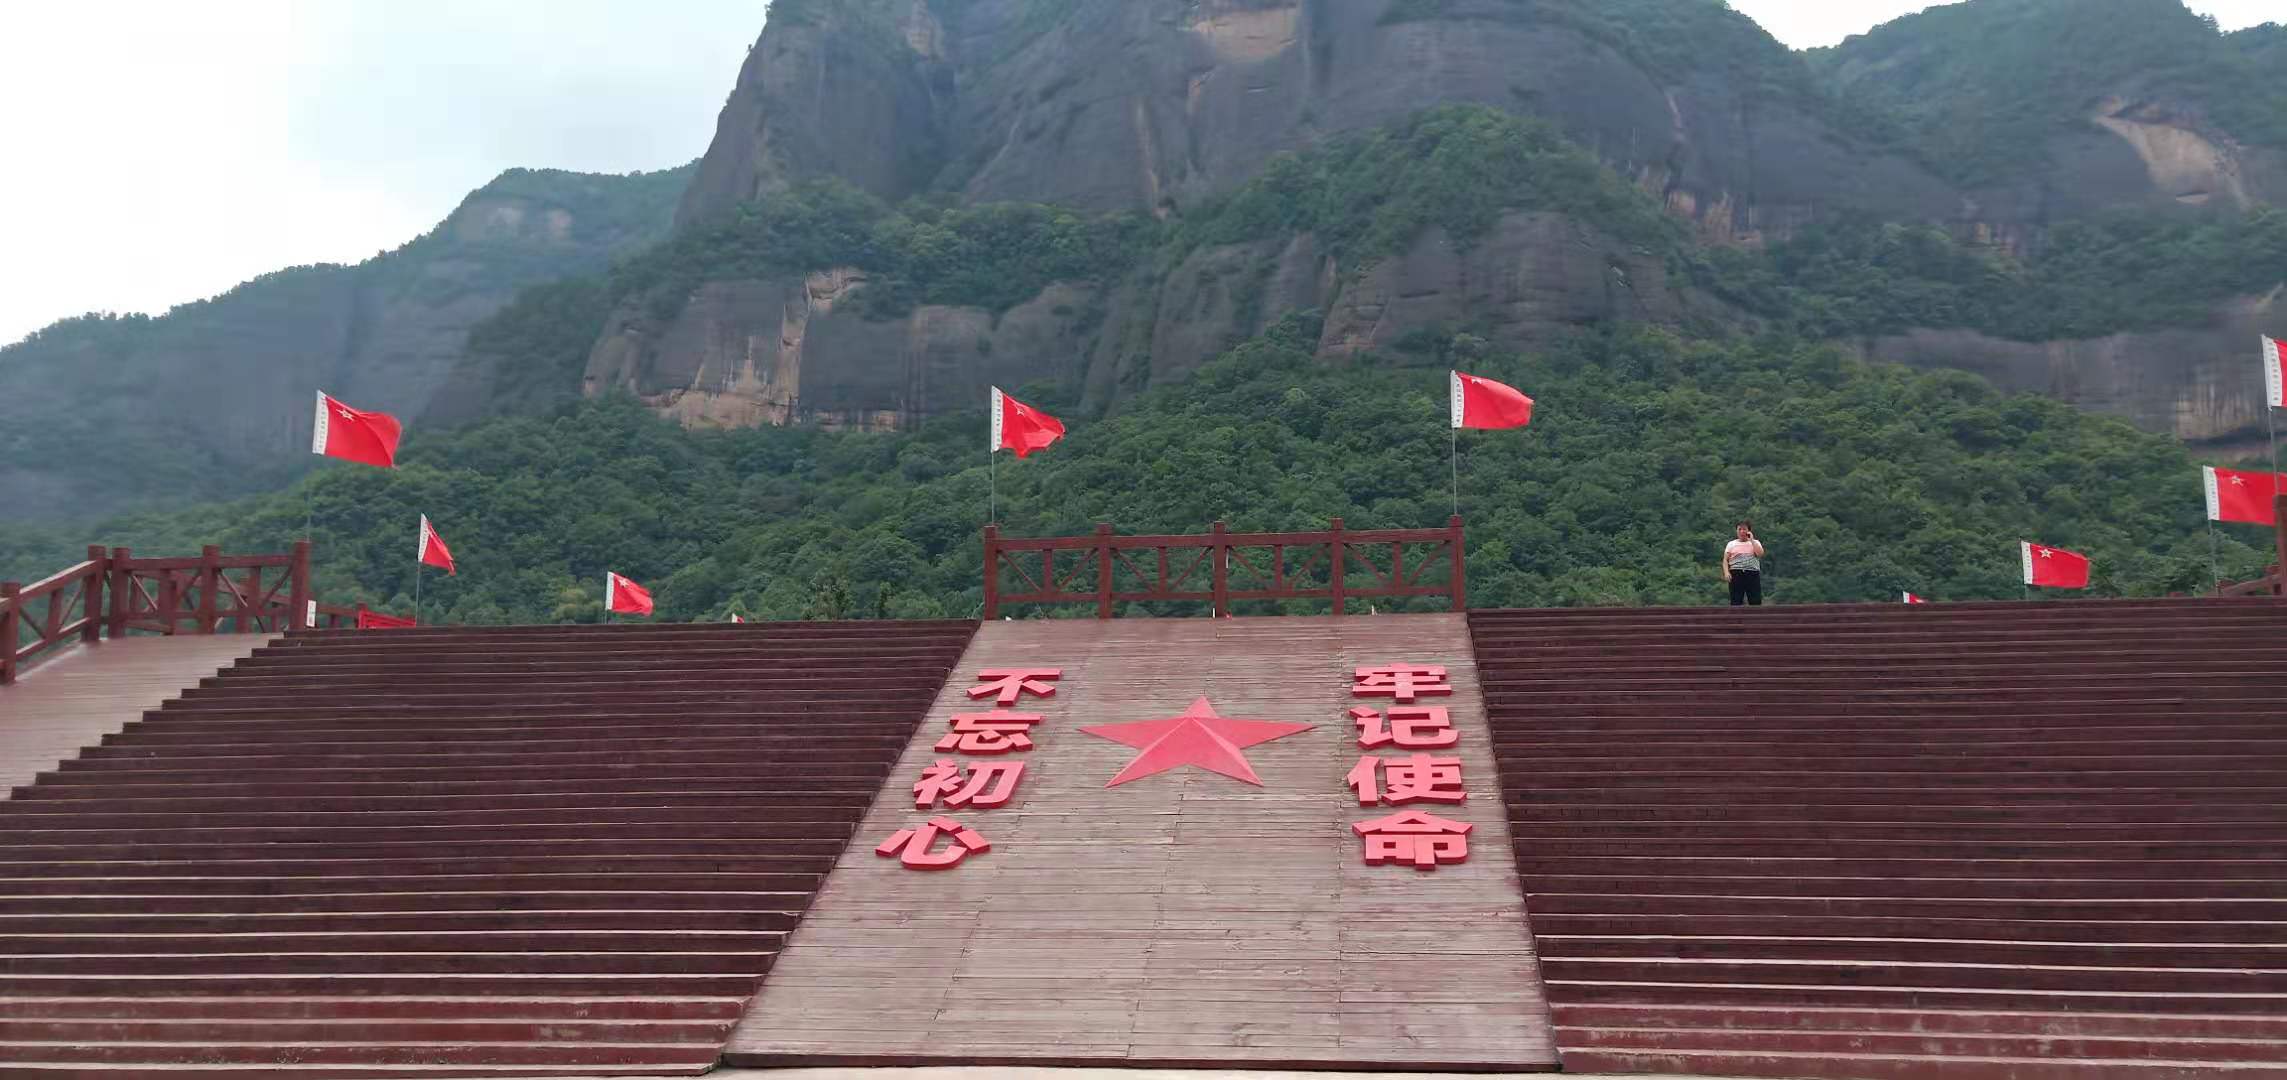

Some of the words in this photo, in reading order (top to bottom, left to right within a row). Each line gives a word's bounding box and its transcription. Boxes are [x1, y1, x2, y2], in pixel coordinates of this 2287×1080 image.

[876, 668, 1062, 869] 不忘初心
[1349, 663, 1473, 870] 牢记使命
